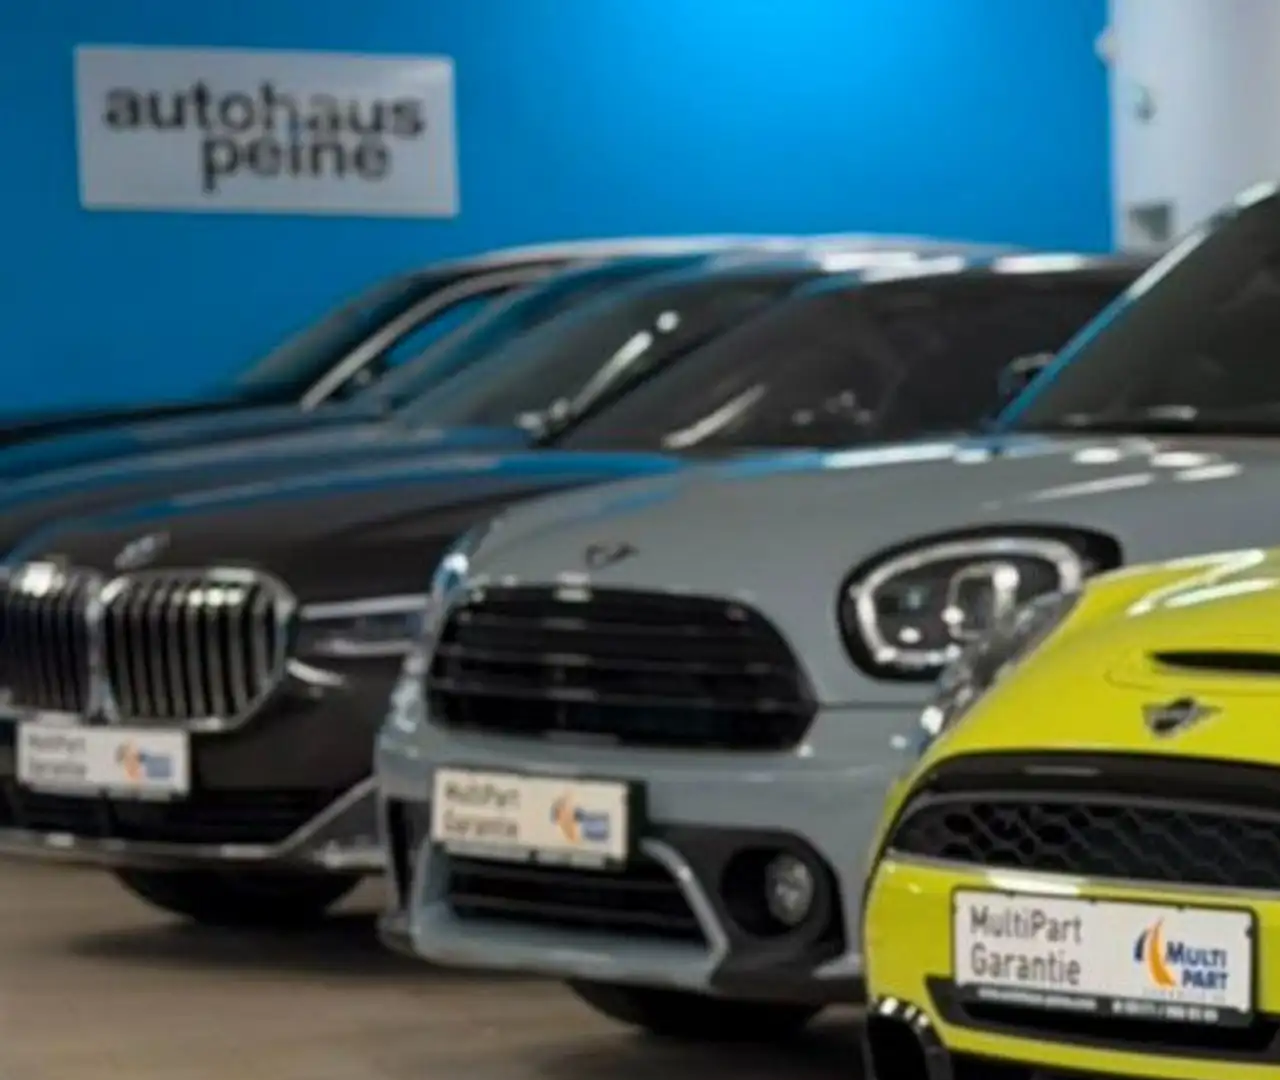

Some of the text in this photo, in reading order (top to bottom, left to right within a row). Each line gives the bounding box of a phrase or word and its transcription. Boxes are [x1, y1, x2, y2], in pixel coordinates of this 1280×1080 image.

[105, 79, 427, 140] autohaus
[202, 120, 391, 195] peine
[969, 904, 1082, 945] MultiPart
[970, 941, 1082, 986] Garantie
